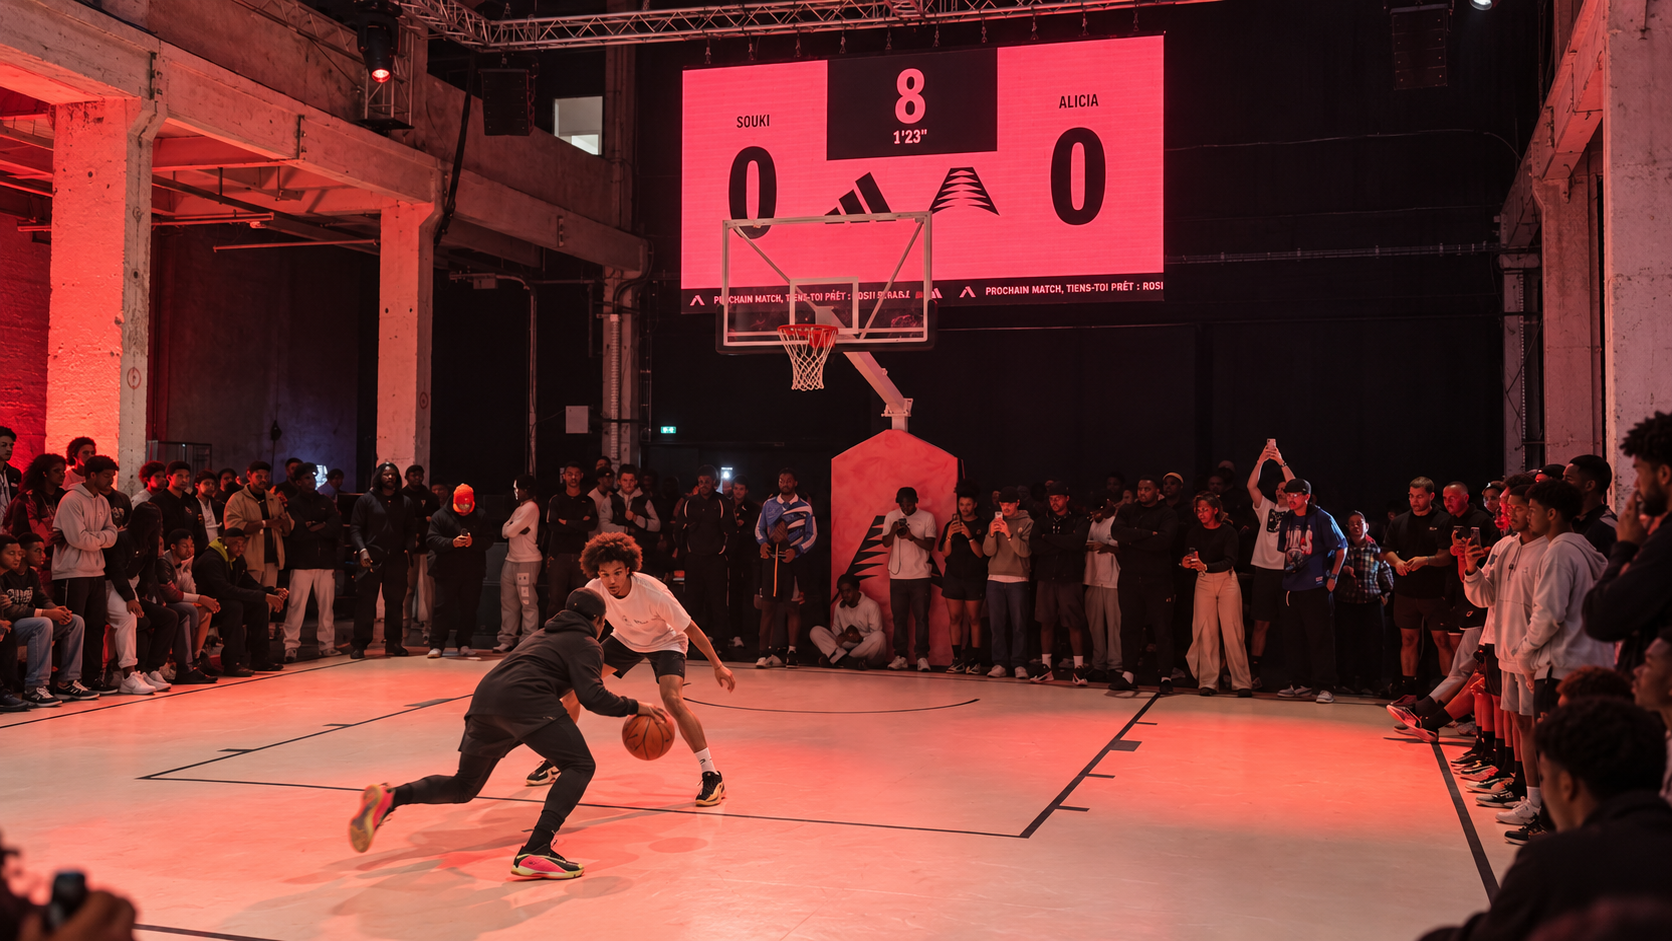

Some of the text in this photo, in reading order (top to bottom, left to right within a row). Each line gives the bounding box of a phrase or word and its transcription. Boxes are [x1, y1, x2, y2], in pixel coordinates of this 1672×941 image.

[895, 68, 926, 124] 8
[1059, 94, 1099, 109] ALICIA
[736, 114, 770, 128] SOUKI
[893, 129, 927, 144] 1'23"
[1051, 127, 1105, 225] 0
[729, 146, 777, 239] 0
[985, 286, 1030, 296] PROCHAIN
[1032, 284, 1064, 295] MATCH,
[1066, 283, 1109, 293] TIENS-TOI
[1142, 281, 1164, 291] ROSI
